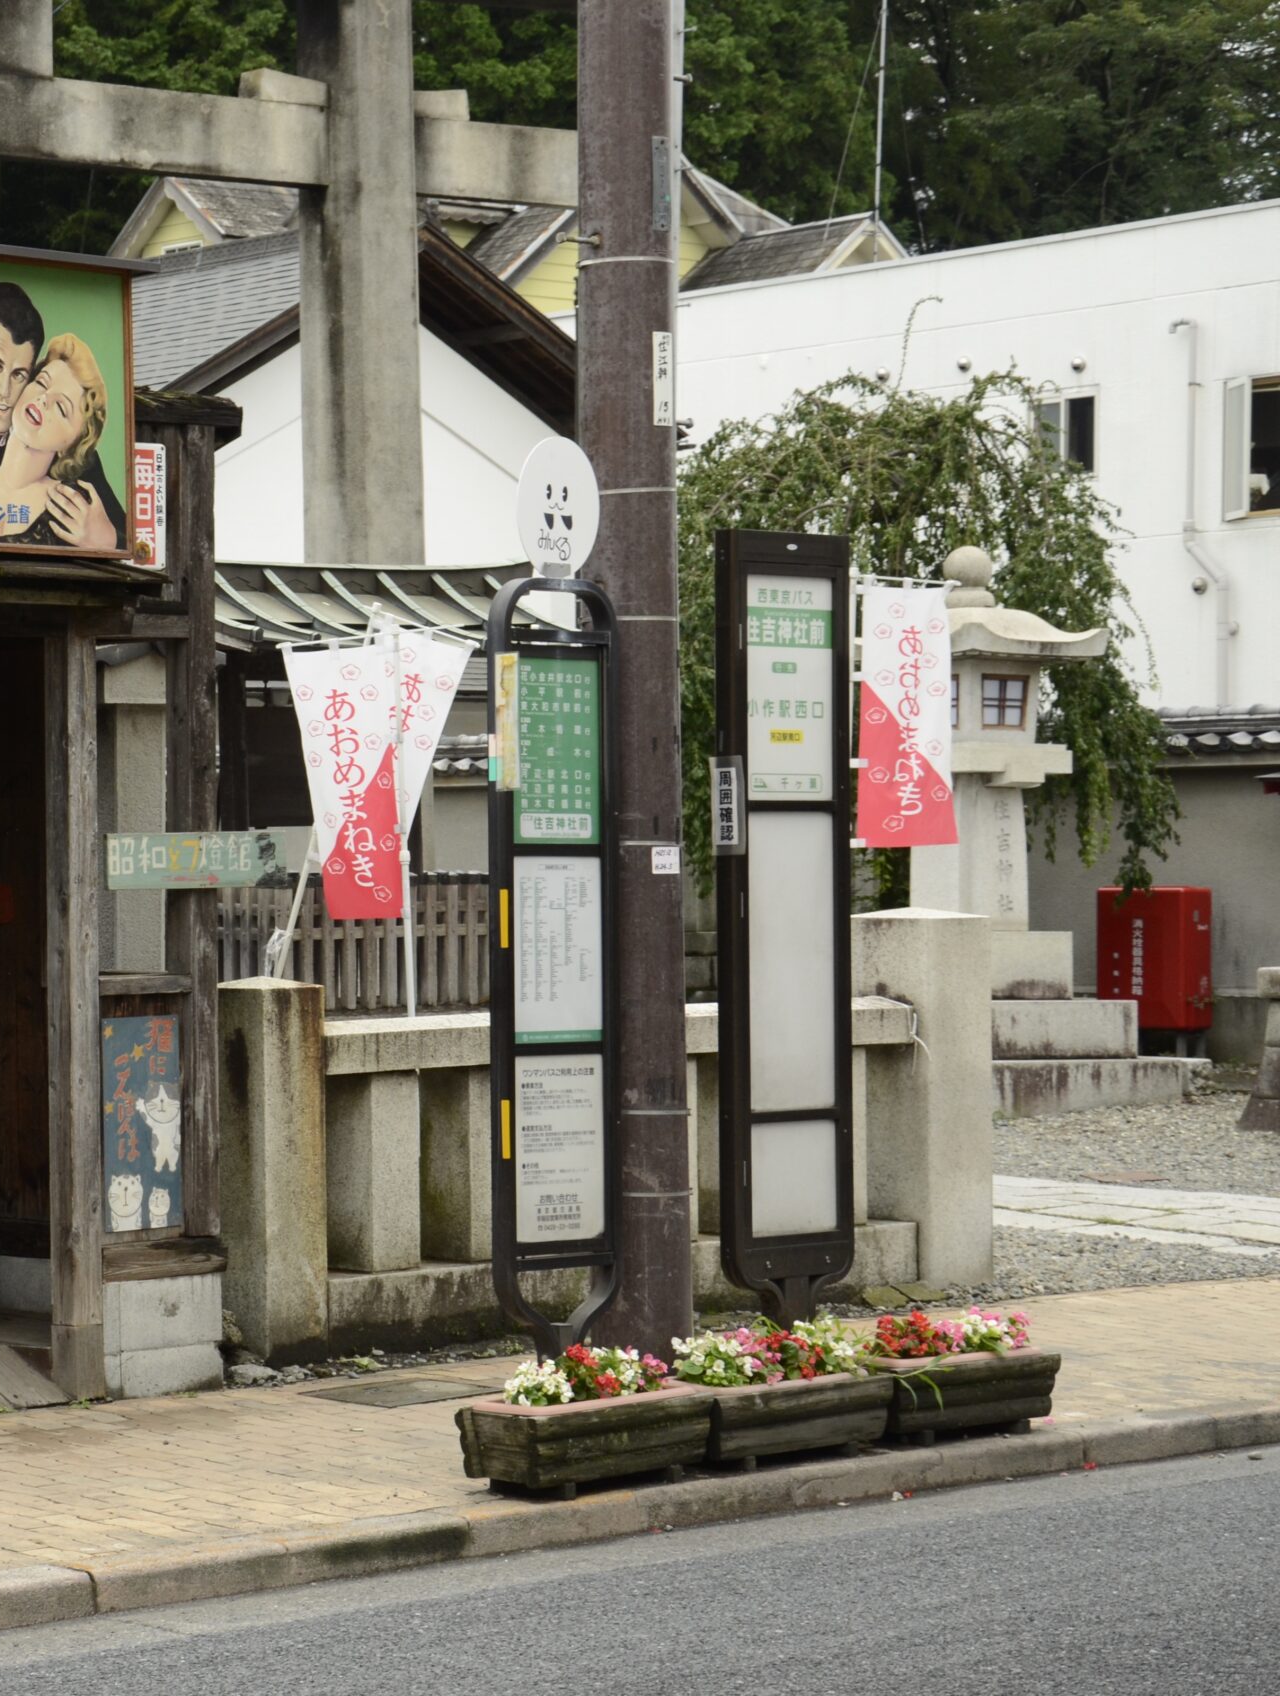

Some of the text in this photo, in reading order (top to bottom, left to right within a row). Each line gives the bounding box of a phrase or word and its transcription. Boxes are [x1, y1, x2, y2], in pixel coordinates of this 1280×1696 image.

[757, 588, 814, 605] 西東京バス
[534, 816, 588, 831] 住吉神社前
[719, 771, 735, 841] 周囲確認
[144, 1018, 175, 1076] 猫に
